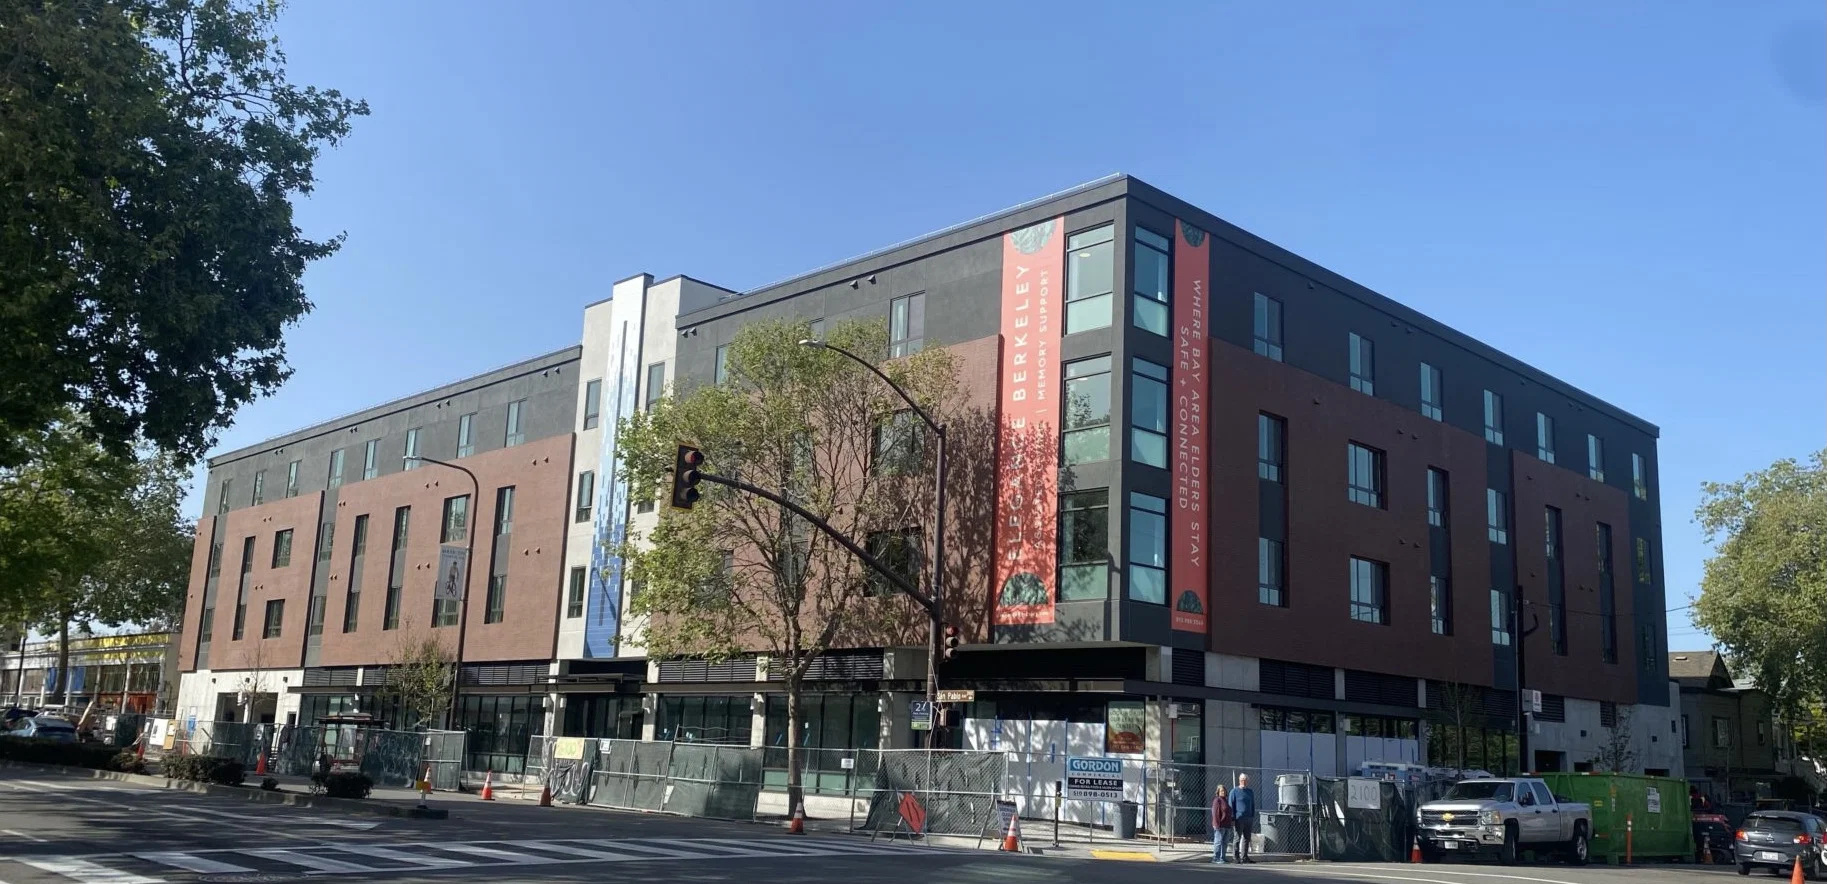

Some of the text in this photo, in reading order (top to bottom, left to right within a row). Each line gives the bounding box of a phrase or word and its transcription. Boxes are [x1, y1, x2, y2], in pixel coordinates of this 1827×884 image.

[1039, 269, 1049, 333] SUPPORT
[1037, 340, 1047, 400] MEMORY
[1180, 325, 1190, 371] SAFE
[1008, 265, 1030, 561] ELEGANCE BERKELEY
[1191, 279, 1202, 567] WHERE BAY AREA ELDERS STAY
[1179, 395, 1188, 509] CONNECTED
[947, 691, 961, 700] Pablo
[1072, 760, 1119, 772] GORDON
[1350, 785, 1378, 801] 2100
